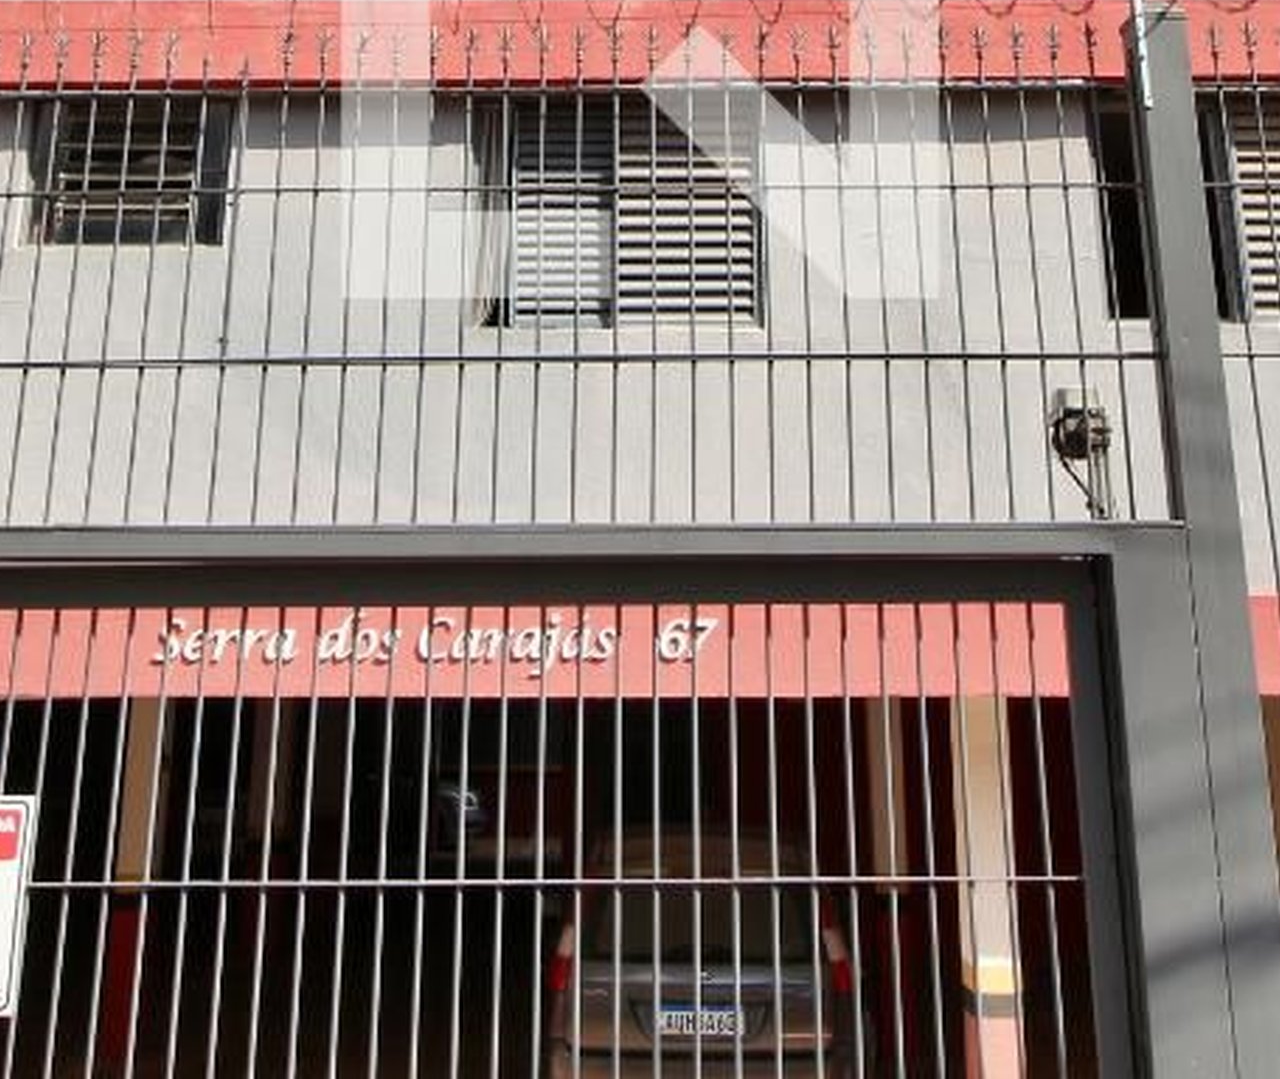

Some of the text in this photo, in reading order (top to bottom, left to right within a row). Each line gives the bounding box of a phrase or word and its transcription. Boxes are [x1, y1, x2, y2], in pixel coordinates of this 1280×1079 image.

[153, 606, 719, 677] Serra dos Carajás 67
